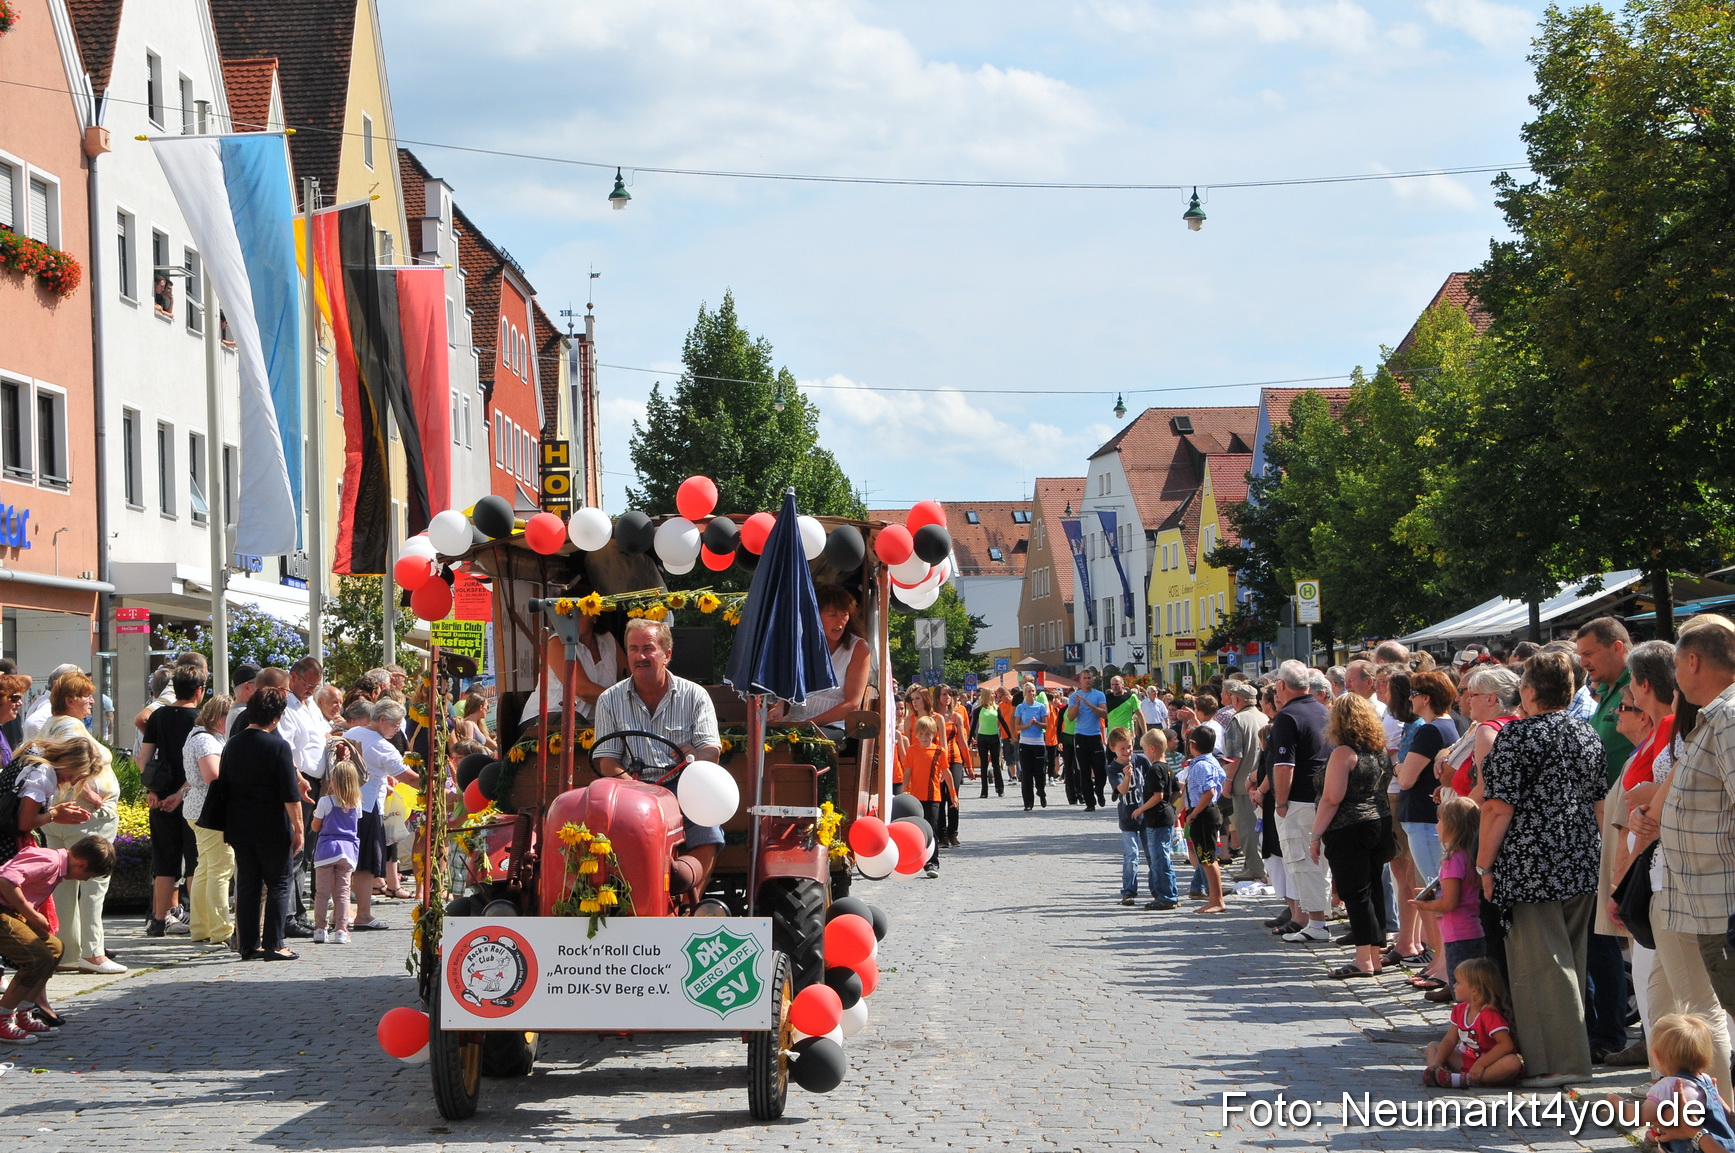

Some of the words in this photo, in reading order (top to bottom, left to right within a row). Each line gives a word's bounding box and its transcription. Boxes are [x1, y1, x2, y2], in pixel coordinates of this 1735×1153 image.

[441, 621, 462, 631] Berlin
[464, 622, 482, 632] Club
[1229, 654, 1235, 665] P
[632, 944, 661, 956] Club
[479, 954, 495, 964] Club
[605, 964, 627, 976] the
[693, 967, 724, 994] BERG
[729, 945, 753, 966] OPF.
[547, 983, 563, 994] im
[567, 983, 612, 995] DJK-SV
[615, 983, 644, 997] Berg
[647, 983, 670, 995] e.V.
[716, 970, 749, 1006] SV
